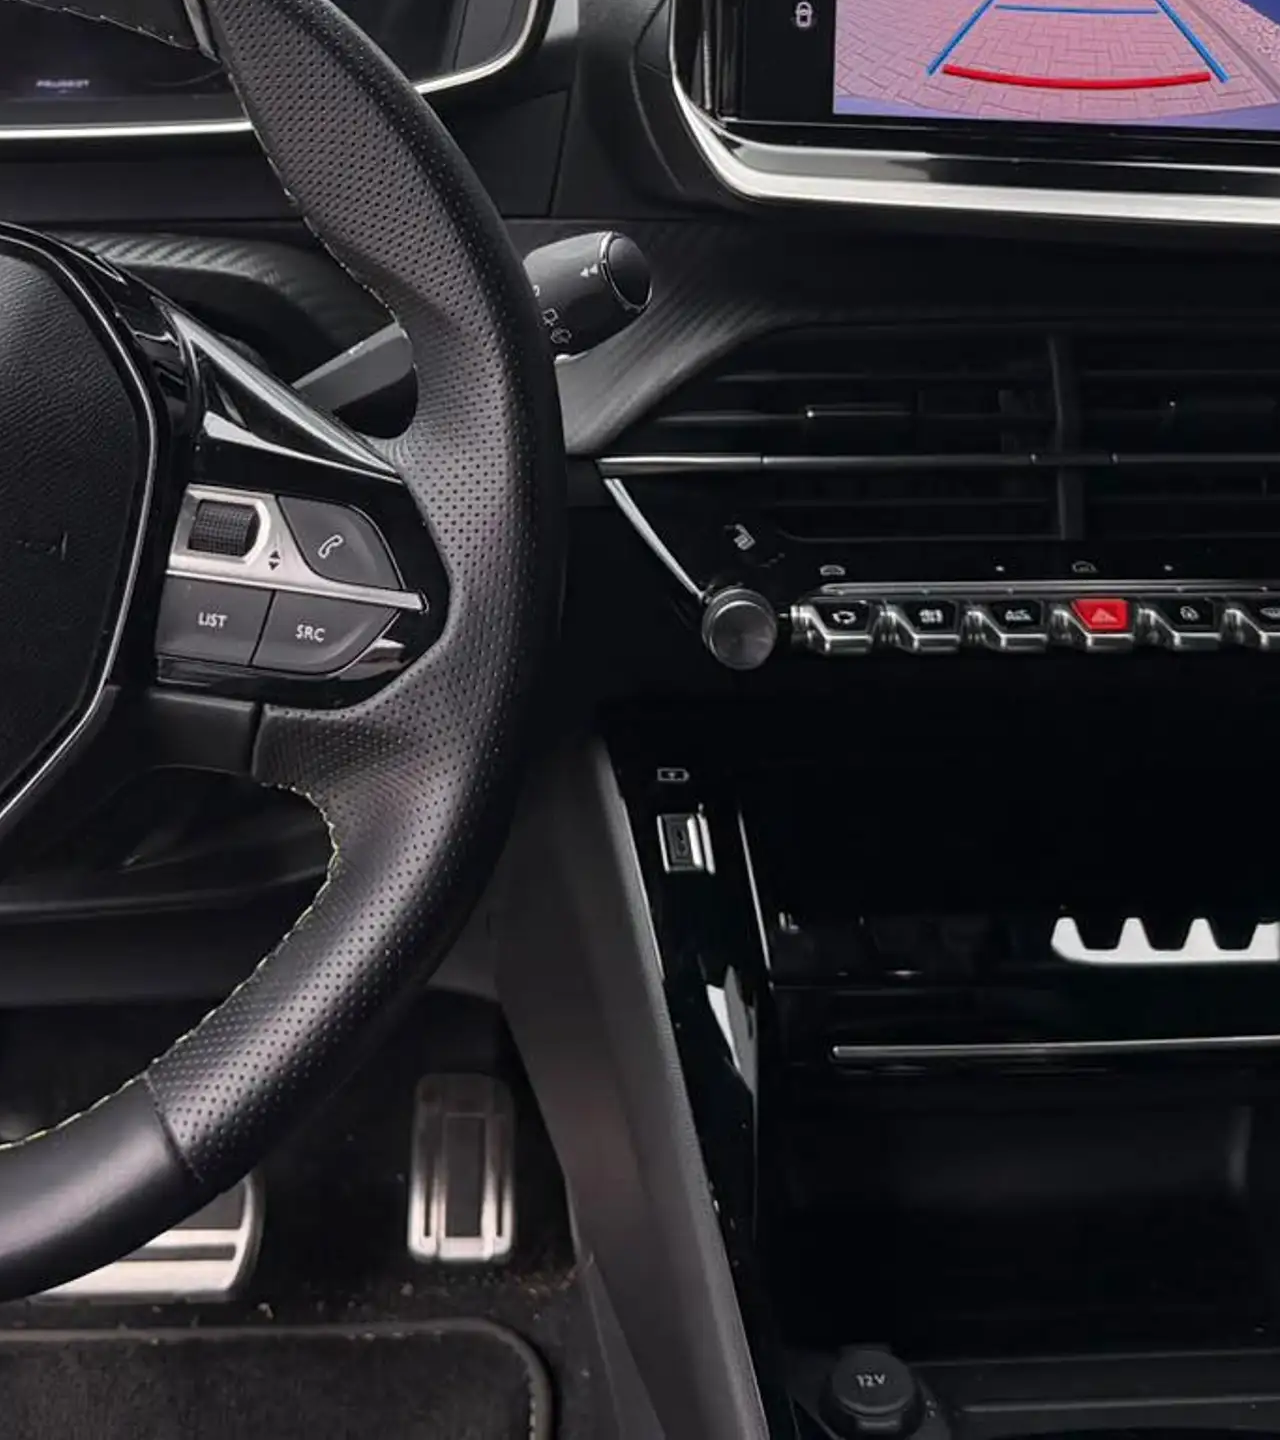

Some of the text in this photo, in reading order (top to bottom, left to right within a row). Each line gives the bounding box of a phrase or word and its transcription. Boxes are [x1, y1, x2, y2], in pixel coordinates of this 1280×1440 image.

[197, 611, 228, 628] LIST
[295, 623, 326, 643] SRC
[855, 1373, 886, 1388] 12V
